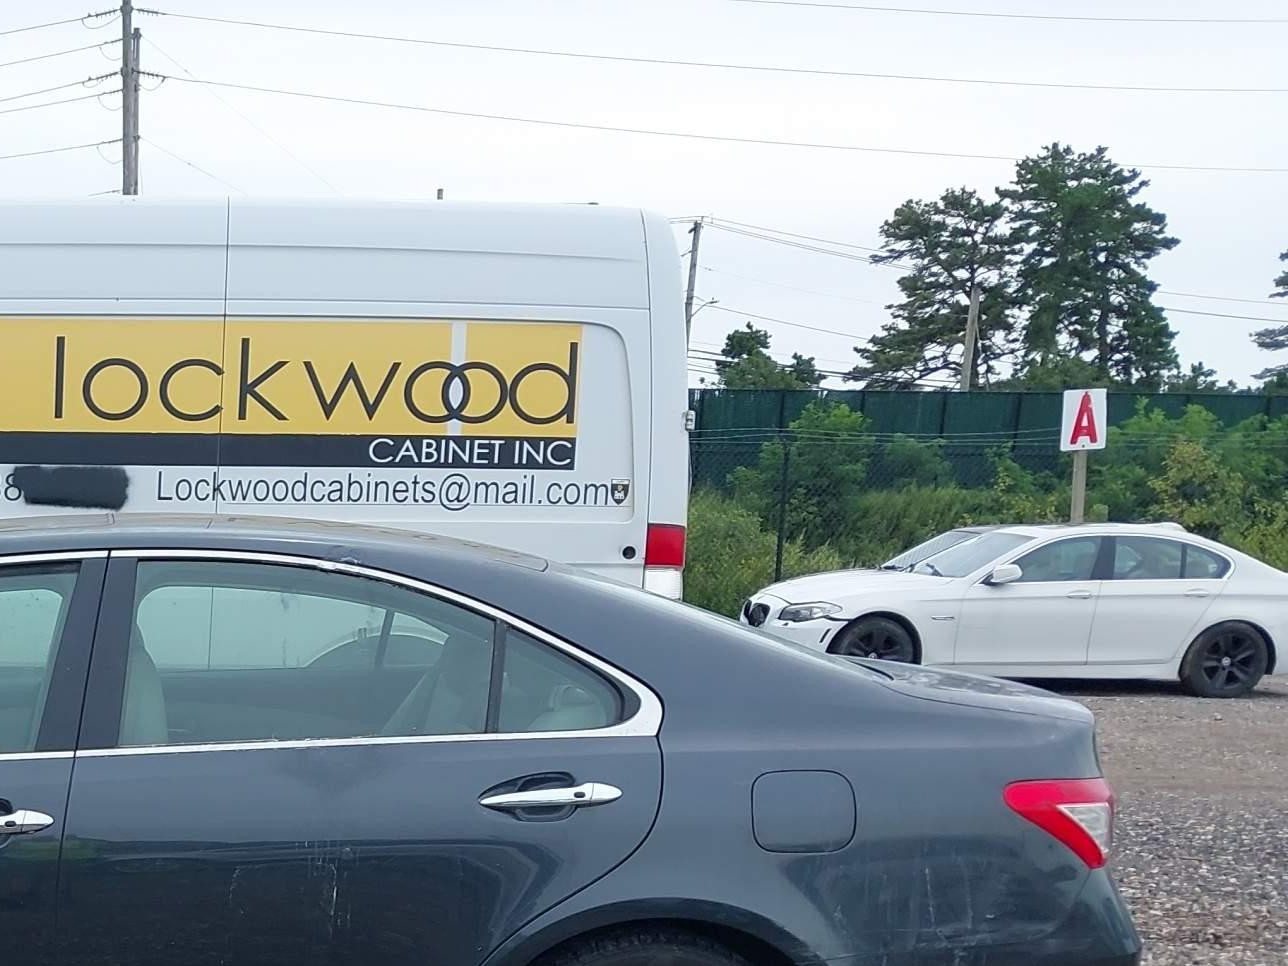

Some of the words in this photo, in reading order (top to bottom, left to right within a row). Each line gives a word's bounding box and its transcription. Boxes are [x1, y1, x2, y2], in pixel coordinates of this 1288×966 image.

[54, 336, 579, 425] lockwood
[1069, 391, 1098, 445] A
[368, 438, 506, 464] CABINET
[513, 440, 573, 466] INC
[157, 470, 609, 512] Lockwoodcabinets@mail.com
